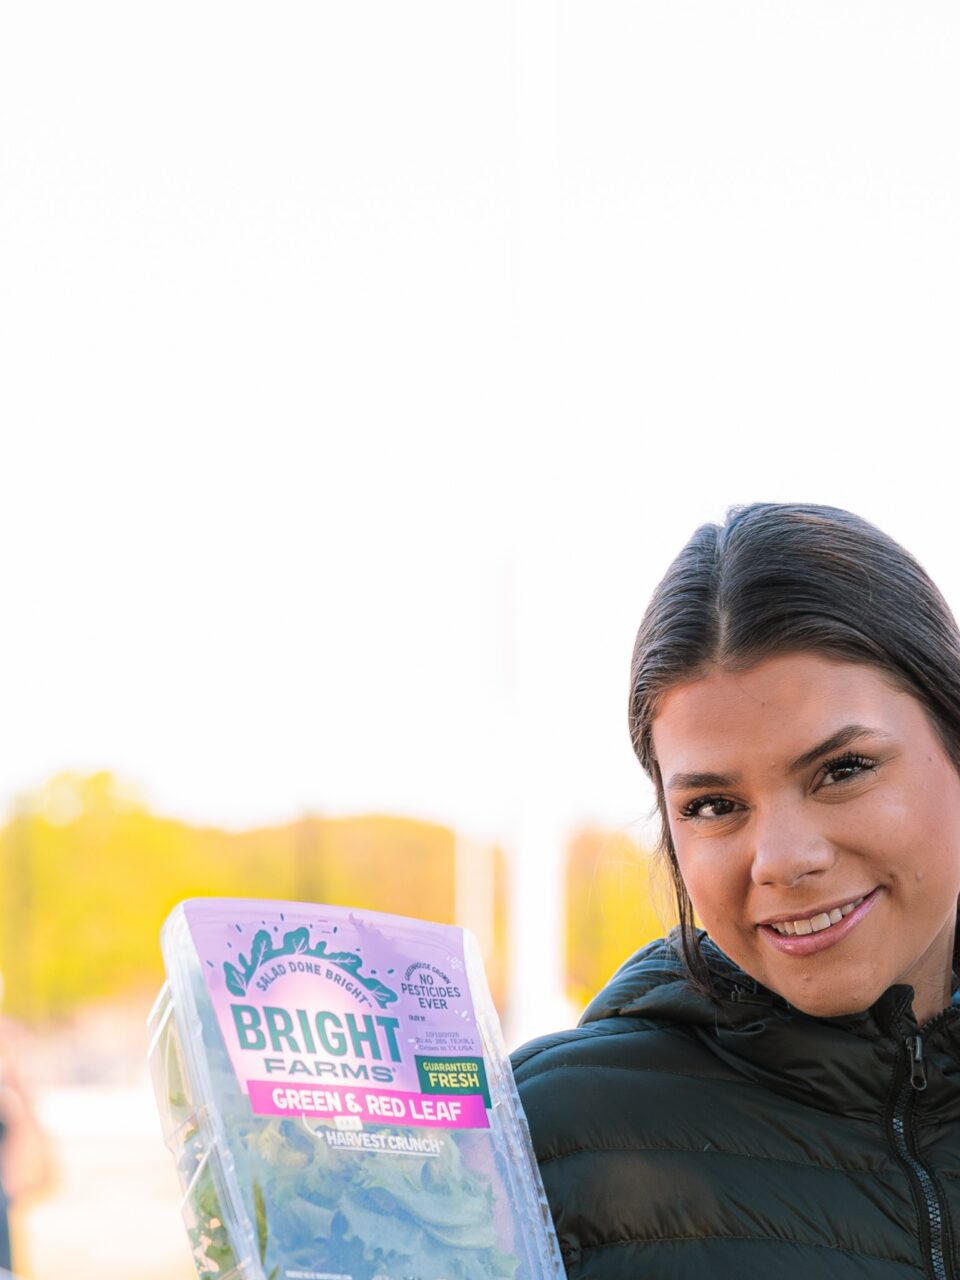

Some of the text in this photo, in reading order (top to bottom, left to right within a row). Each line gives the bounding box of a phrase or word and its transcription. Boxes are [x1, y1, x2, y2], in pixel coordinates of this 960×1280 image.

[256, 964, 286, 991] SALAD
[288, 961, 321, 975] DONE
[419, 973, 434, 985] NO
[401, 983, 461, 998] PESTICIDES
[419, 997, 448, 1009] EVER
[230, 1004, 402, 1062] BRIGHT
[264, 1058, 394, 1083] FARMS
[423, 1062, 478, 1072] GUARANTEED
[428, 1073, 480, 1087] FRESH
[272, 1088, 461, 1121] GREEN & RED LEAF
[326, 1131, 440, 1154] HARVEST CRUNCH
